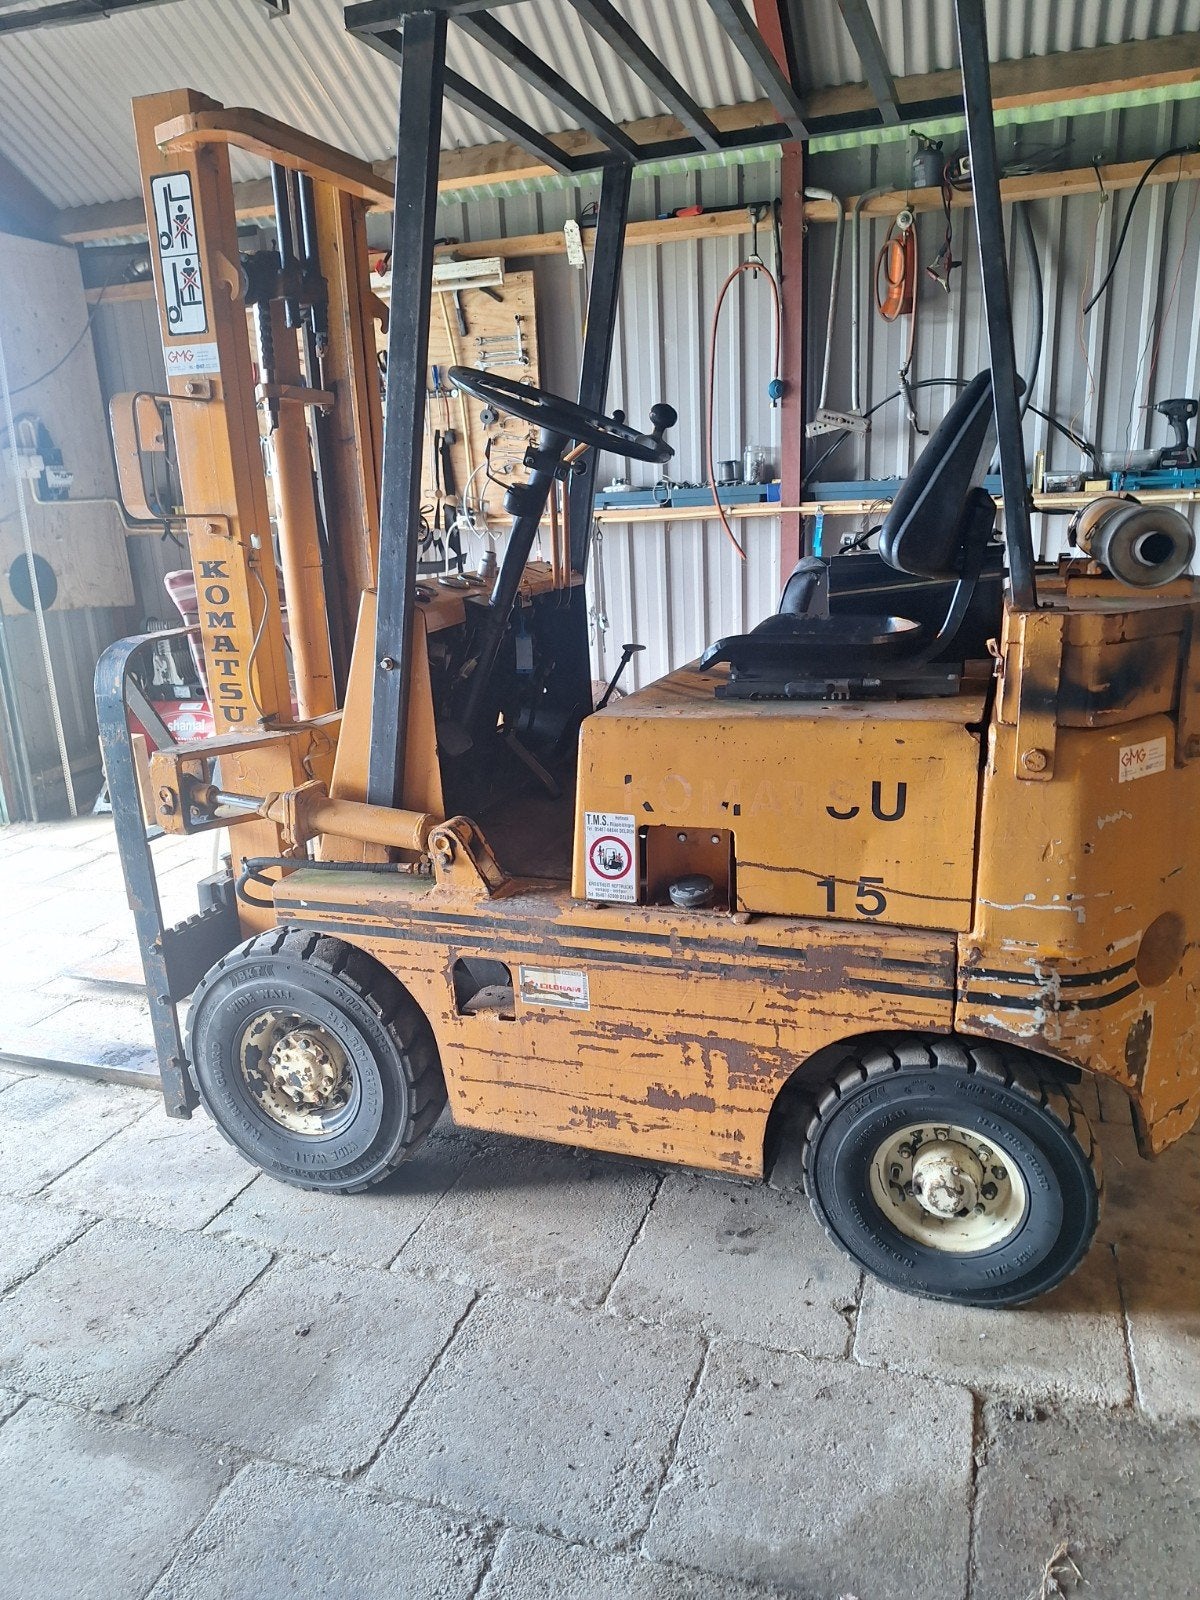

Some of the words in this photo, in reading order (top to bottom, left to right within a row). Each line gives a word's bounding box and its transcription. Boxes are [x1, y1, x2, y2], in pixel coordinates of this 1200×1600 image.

[168, 349, 194, 363] GMG
[198, 560, 248, 723] KOMATSU
[1121, 748, 1147, 767] GMG
[586, 813, 609, 827] T.M.S.
[816, 875, 887, 916] 15
[237, 967, 261, 980] BKT
